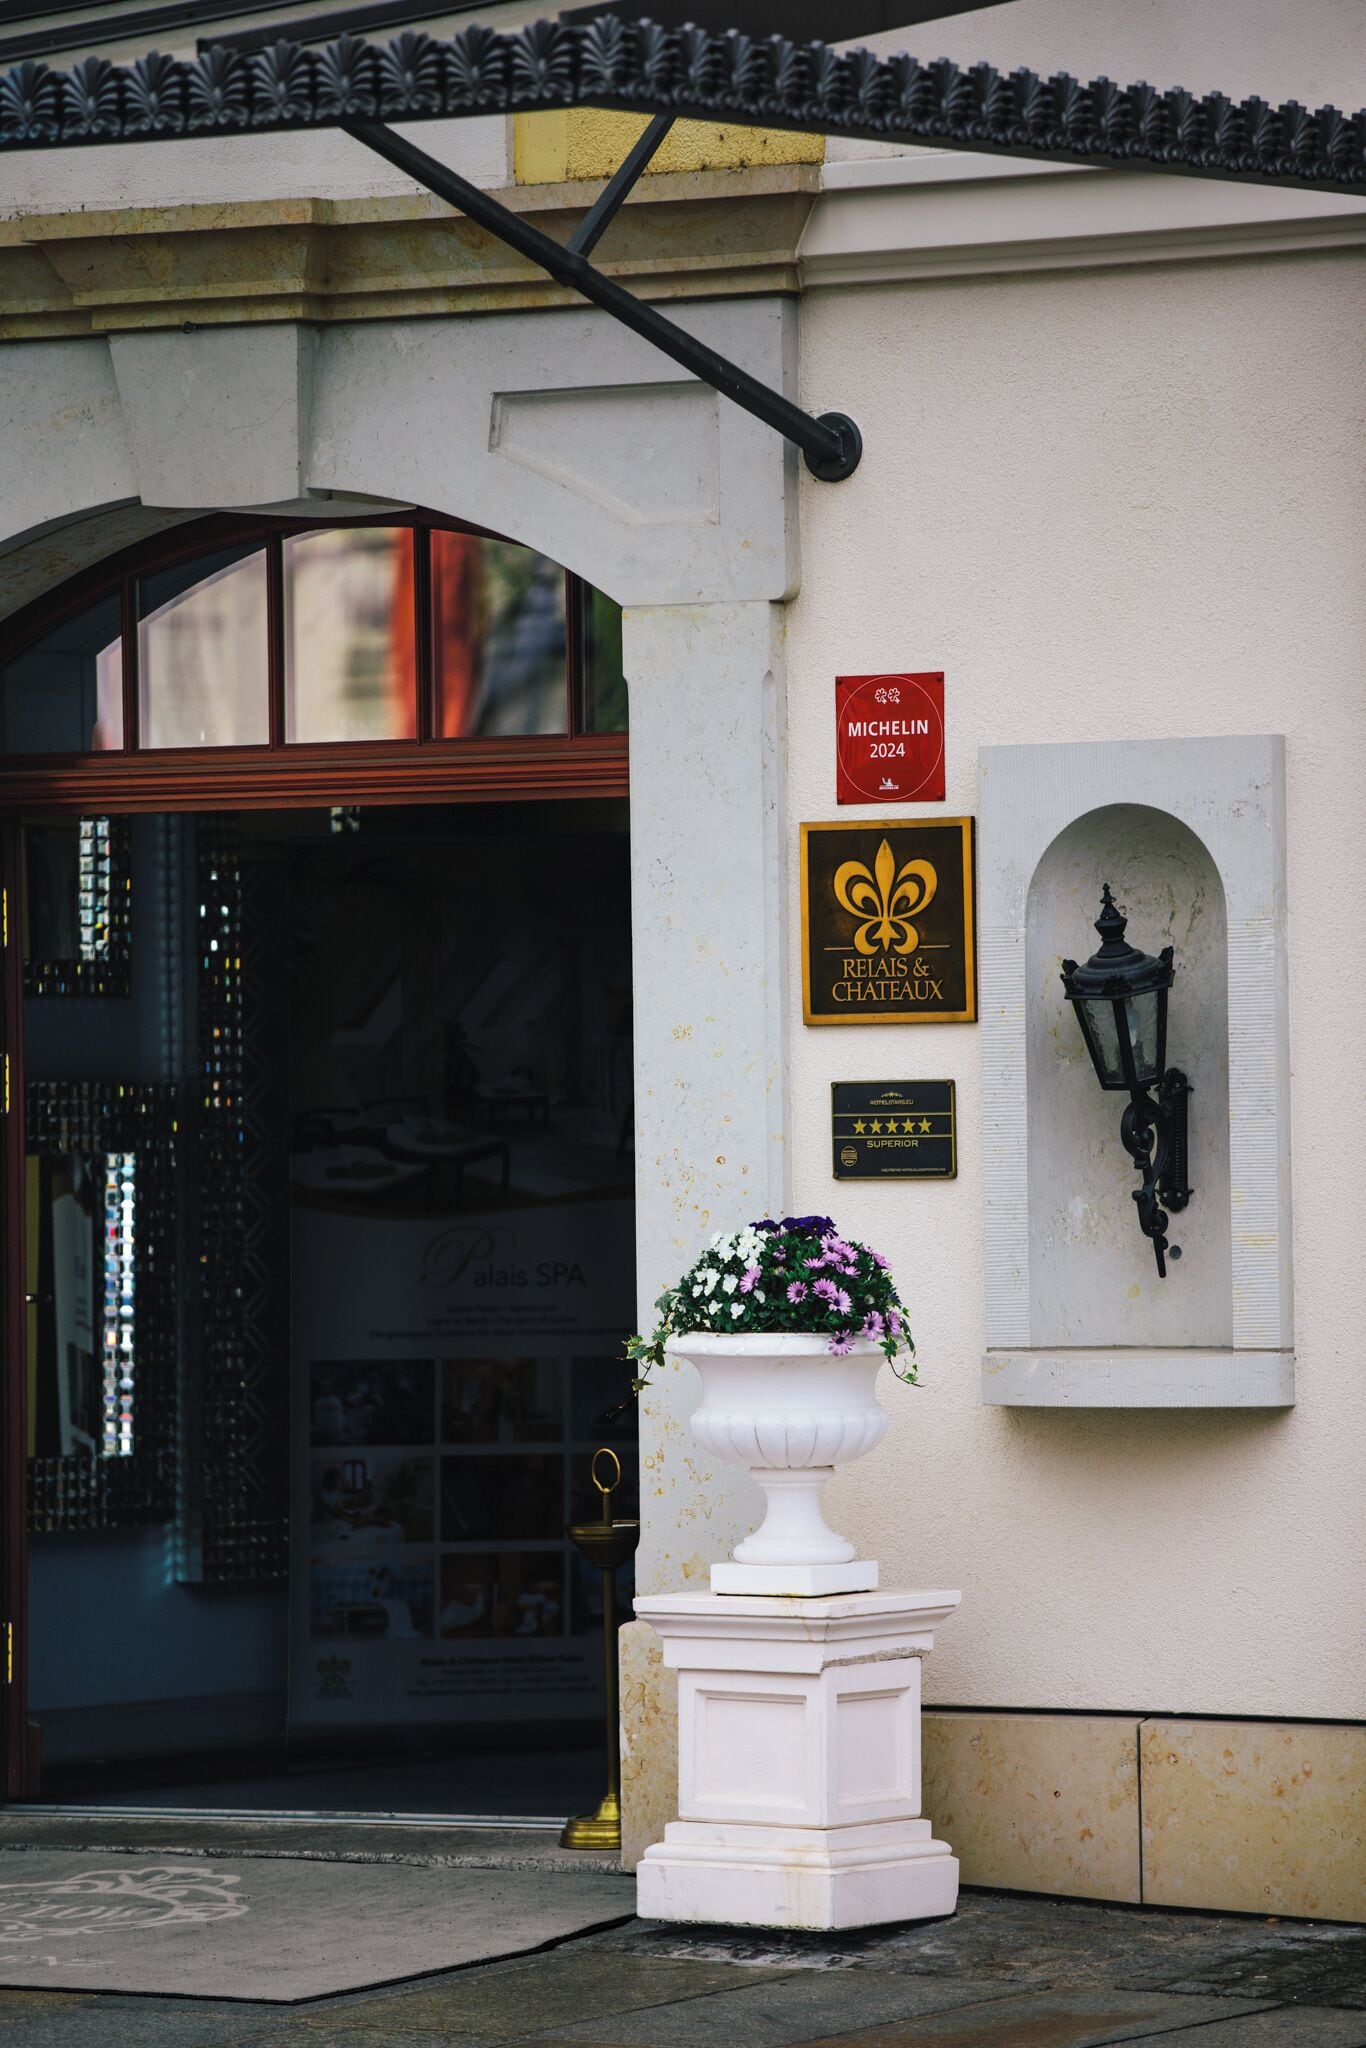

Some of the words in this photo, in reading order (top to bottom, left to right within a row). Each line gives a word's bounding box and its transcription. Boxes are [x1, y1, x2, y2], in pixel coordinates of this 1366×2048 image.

[848, 720, 928, 737] MICHELIN
[870, 743, 905, 758] 2024
[843, 959, 908, 978] RELAIS
[913, 957, 930, 977] &
[832, 980, 943, 1001] CHATEAUX
[866, 1140, 919, 1148] SUPERIOR
[418, 1225, 529, 1289] Palais
[535, 1261, 588, 1287] SPA
